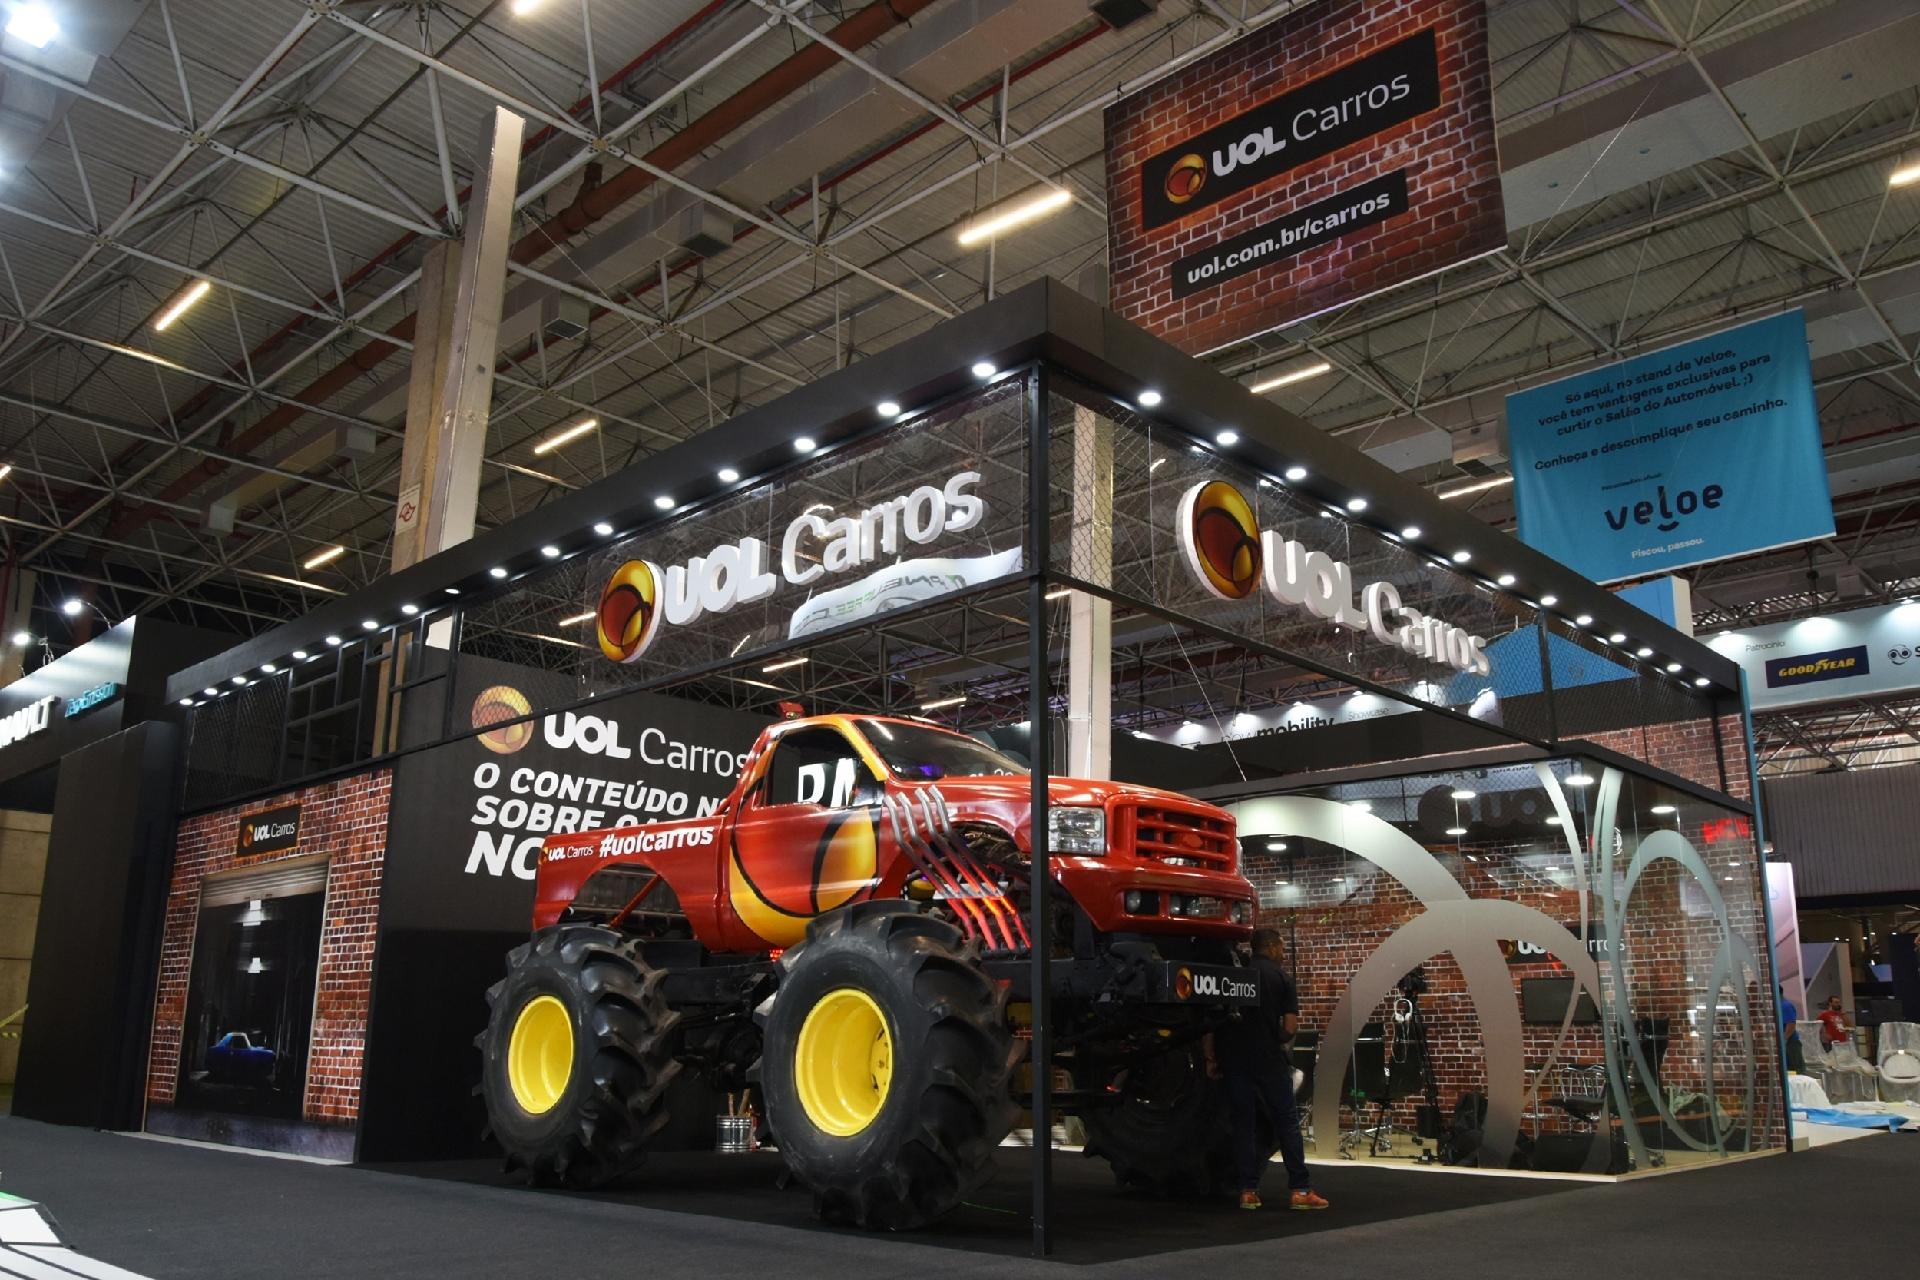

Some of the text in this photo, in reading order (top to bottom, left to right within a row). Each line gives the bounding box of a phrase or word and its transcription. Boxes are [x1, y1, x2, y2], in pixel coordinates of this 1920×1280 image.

[1212, 73, 1410, 177] UOL Carros
[1187, 192, 1390, 285] uol.com.br/carros
[1538, 353, 1771, 426] você tem vantagens exclusivas para
[1635, 364, 1672, 384] stand
[1557, 419, 1592, 436] curtir
[1643, 400, 1661, 413] do
[1663, 376, 1741, 407] Automóvel.
[1534, 450, 1588, 471] Conheça
[1600, 423, 1694, 454] descomplique
[1696, 415, 1721, 429] seu
[1722, 398, 1788, 422] caminho.
[1604, 484, 1724, 531] veloe
[665, 536, 776, 626] UOL
[782, 471, 984, 586] Carros
[1262, 529, 1491, 678] UOL Carros
[1778, 657, 1857, 682] GOODYEAR
[544, 711, 631, 759] UOL
[470, 794, 606, 835] SOBRE
[473, 762, 500, 789] O
[510, 767, 689, 816] CONTEÚDO
[253, 822, 296, 842] UOL Carros
[548, 826, 714, 862] UOL Carros #uolcarros
[1194, 974, 1257, 998] UOL Carros
